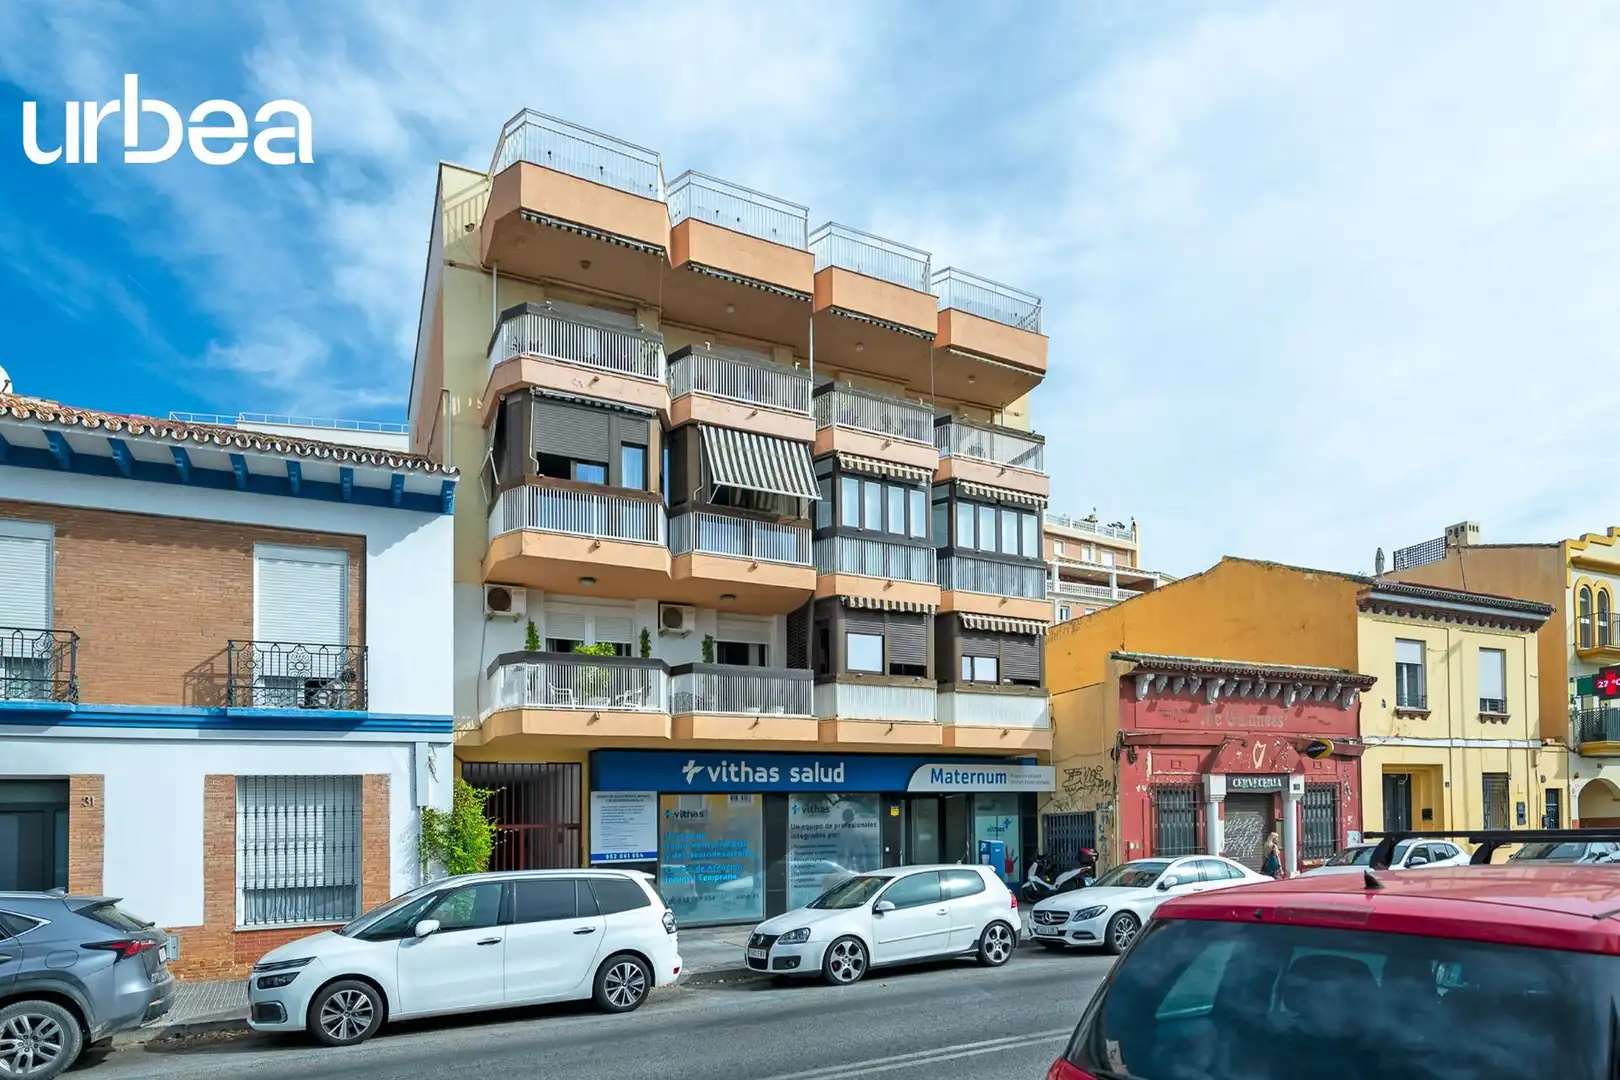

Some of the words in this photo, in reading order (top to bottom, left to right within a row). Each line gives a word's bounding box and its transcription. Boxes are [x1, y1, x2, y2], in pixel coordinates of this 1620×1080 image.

[707, 760, 780, 783] vithas
[789, 761, 845, 783] salud
[930, 767, 1007, 785] Maternum
[674, 809, 704, 818] vithas
[801, 803, 830, 814] vithas
[834, 822, 877, 830] profesionales
